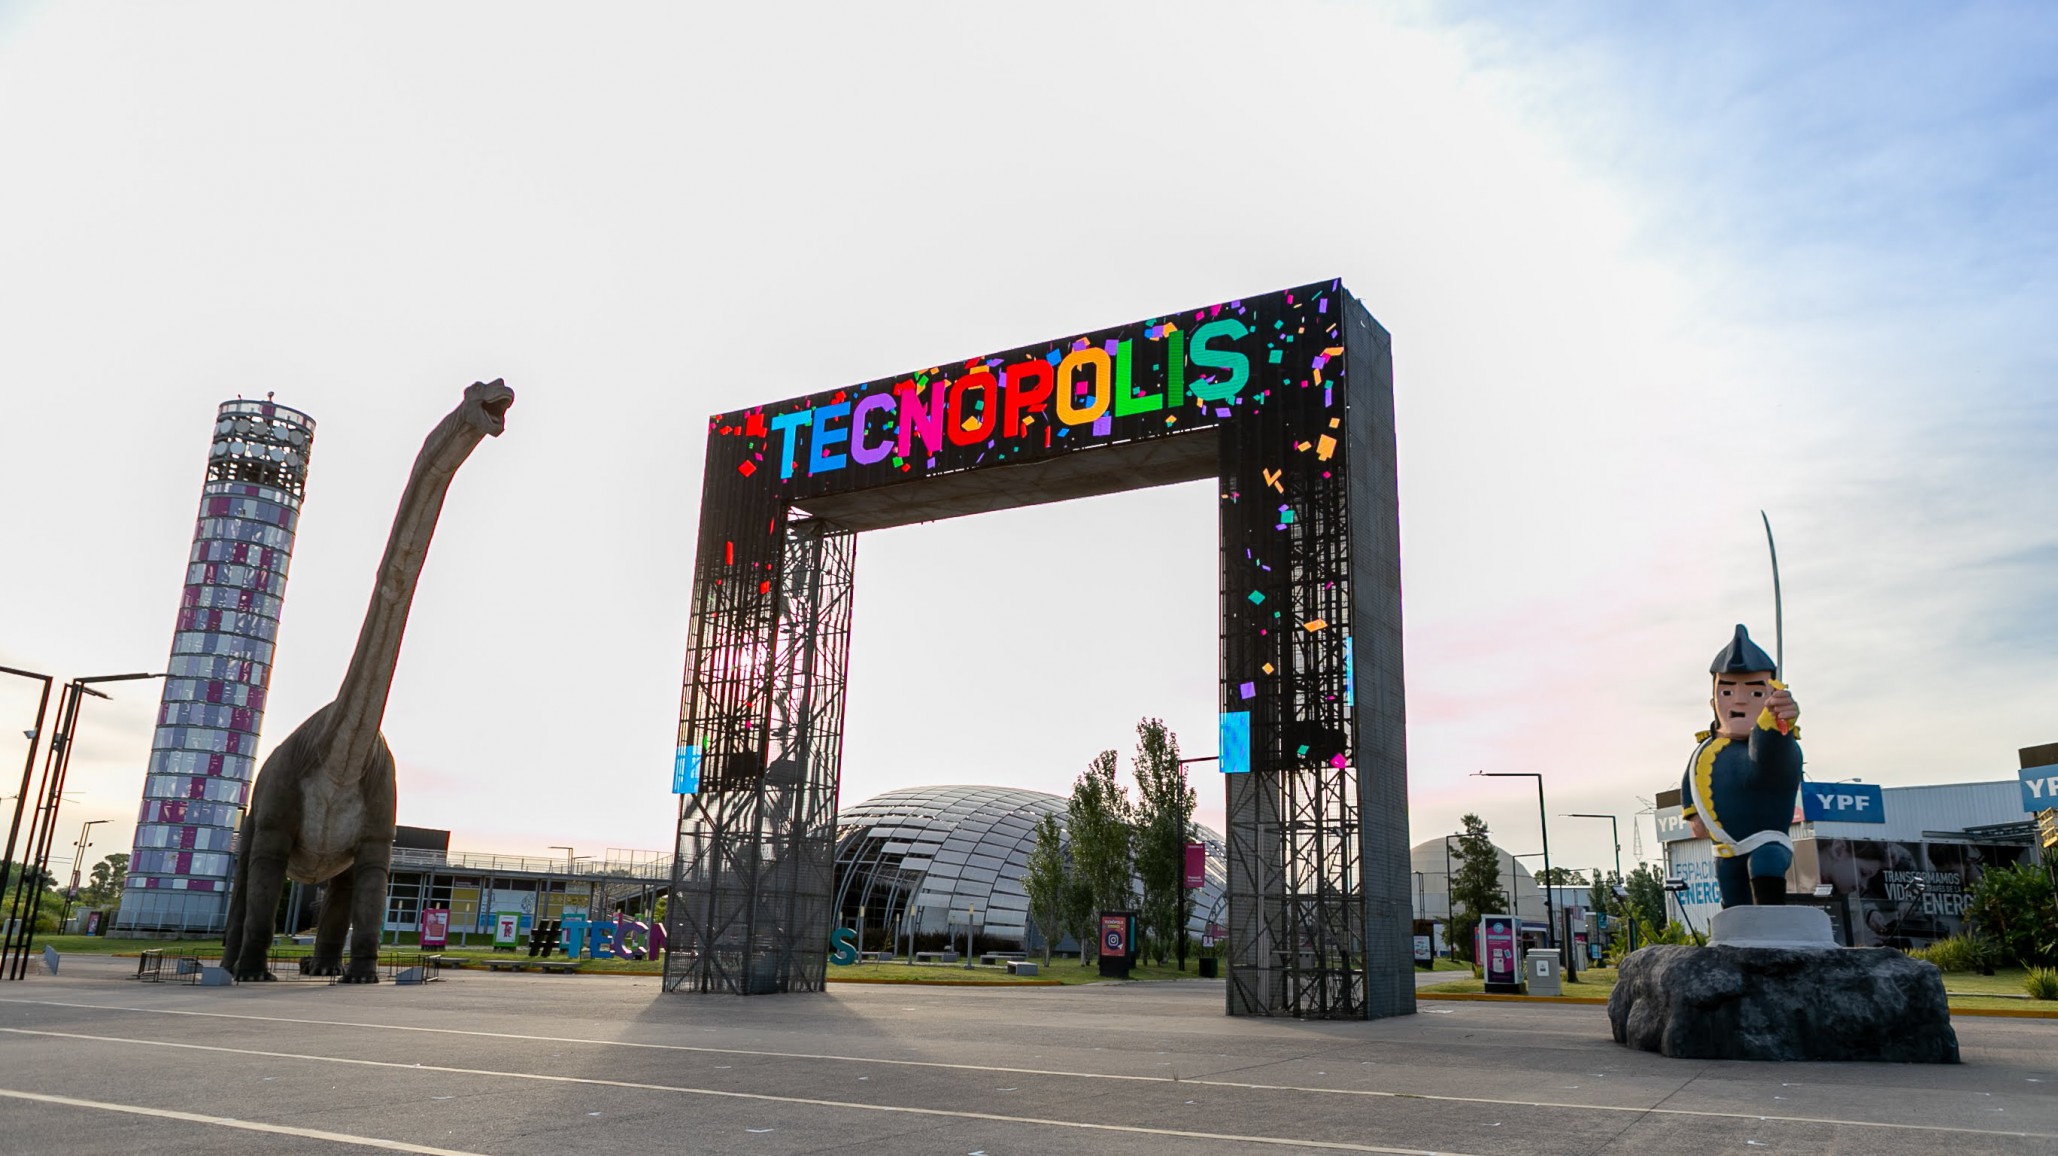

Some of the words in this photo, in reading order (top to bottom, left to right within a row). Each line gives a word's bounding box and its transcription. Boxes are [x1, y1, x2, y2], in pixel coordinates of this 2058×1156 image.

[1816, 793, 1870, 811] YPF
[1658, 815, 1688, 832] YPF
[1884, 883, 1917, 901] VIDA
